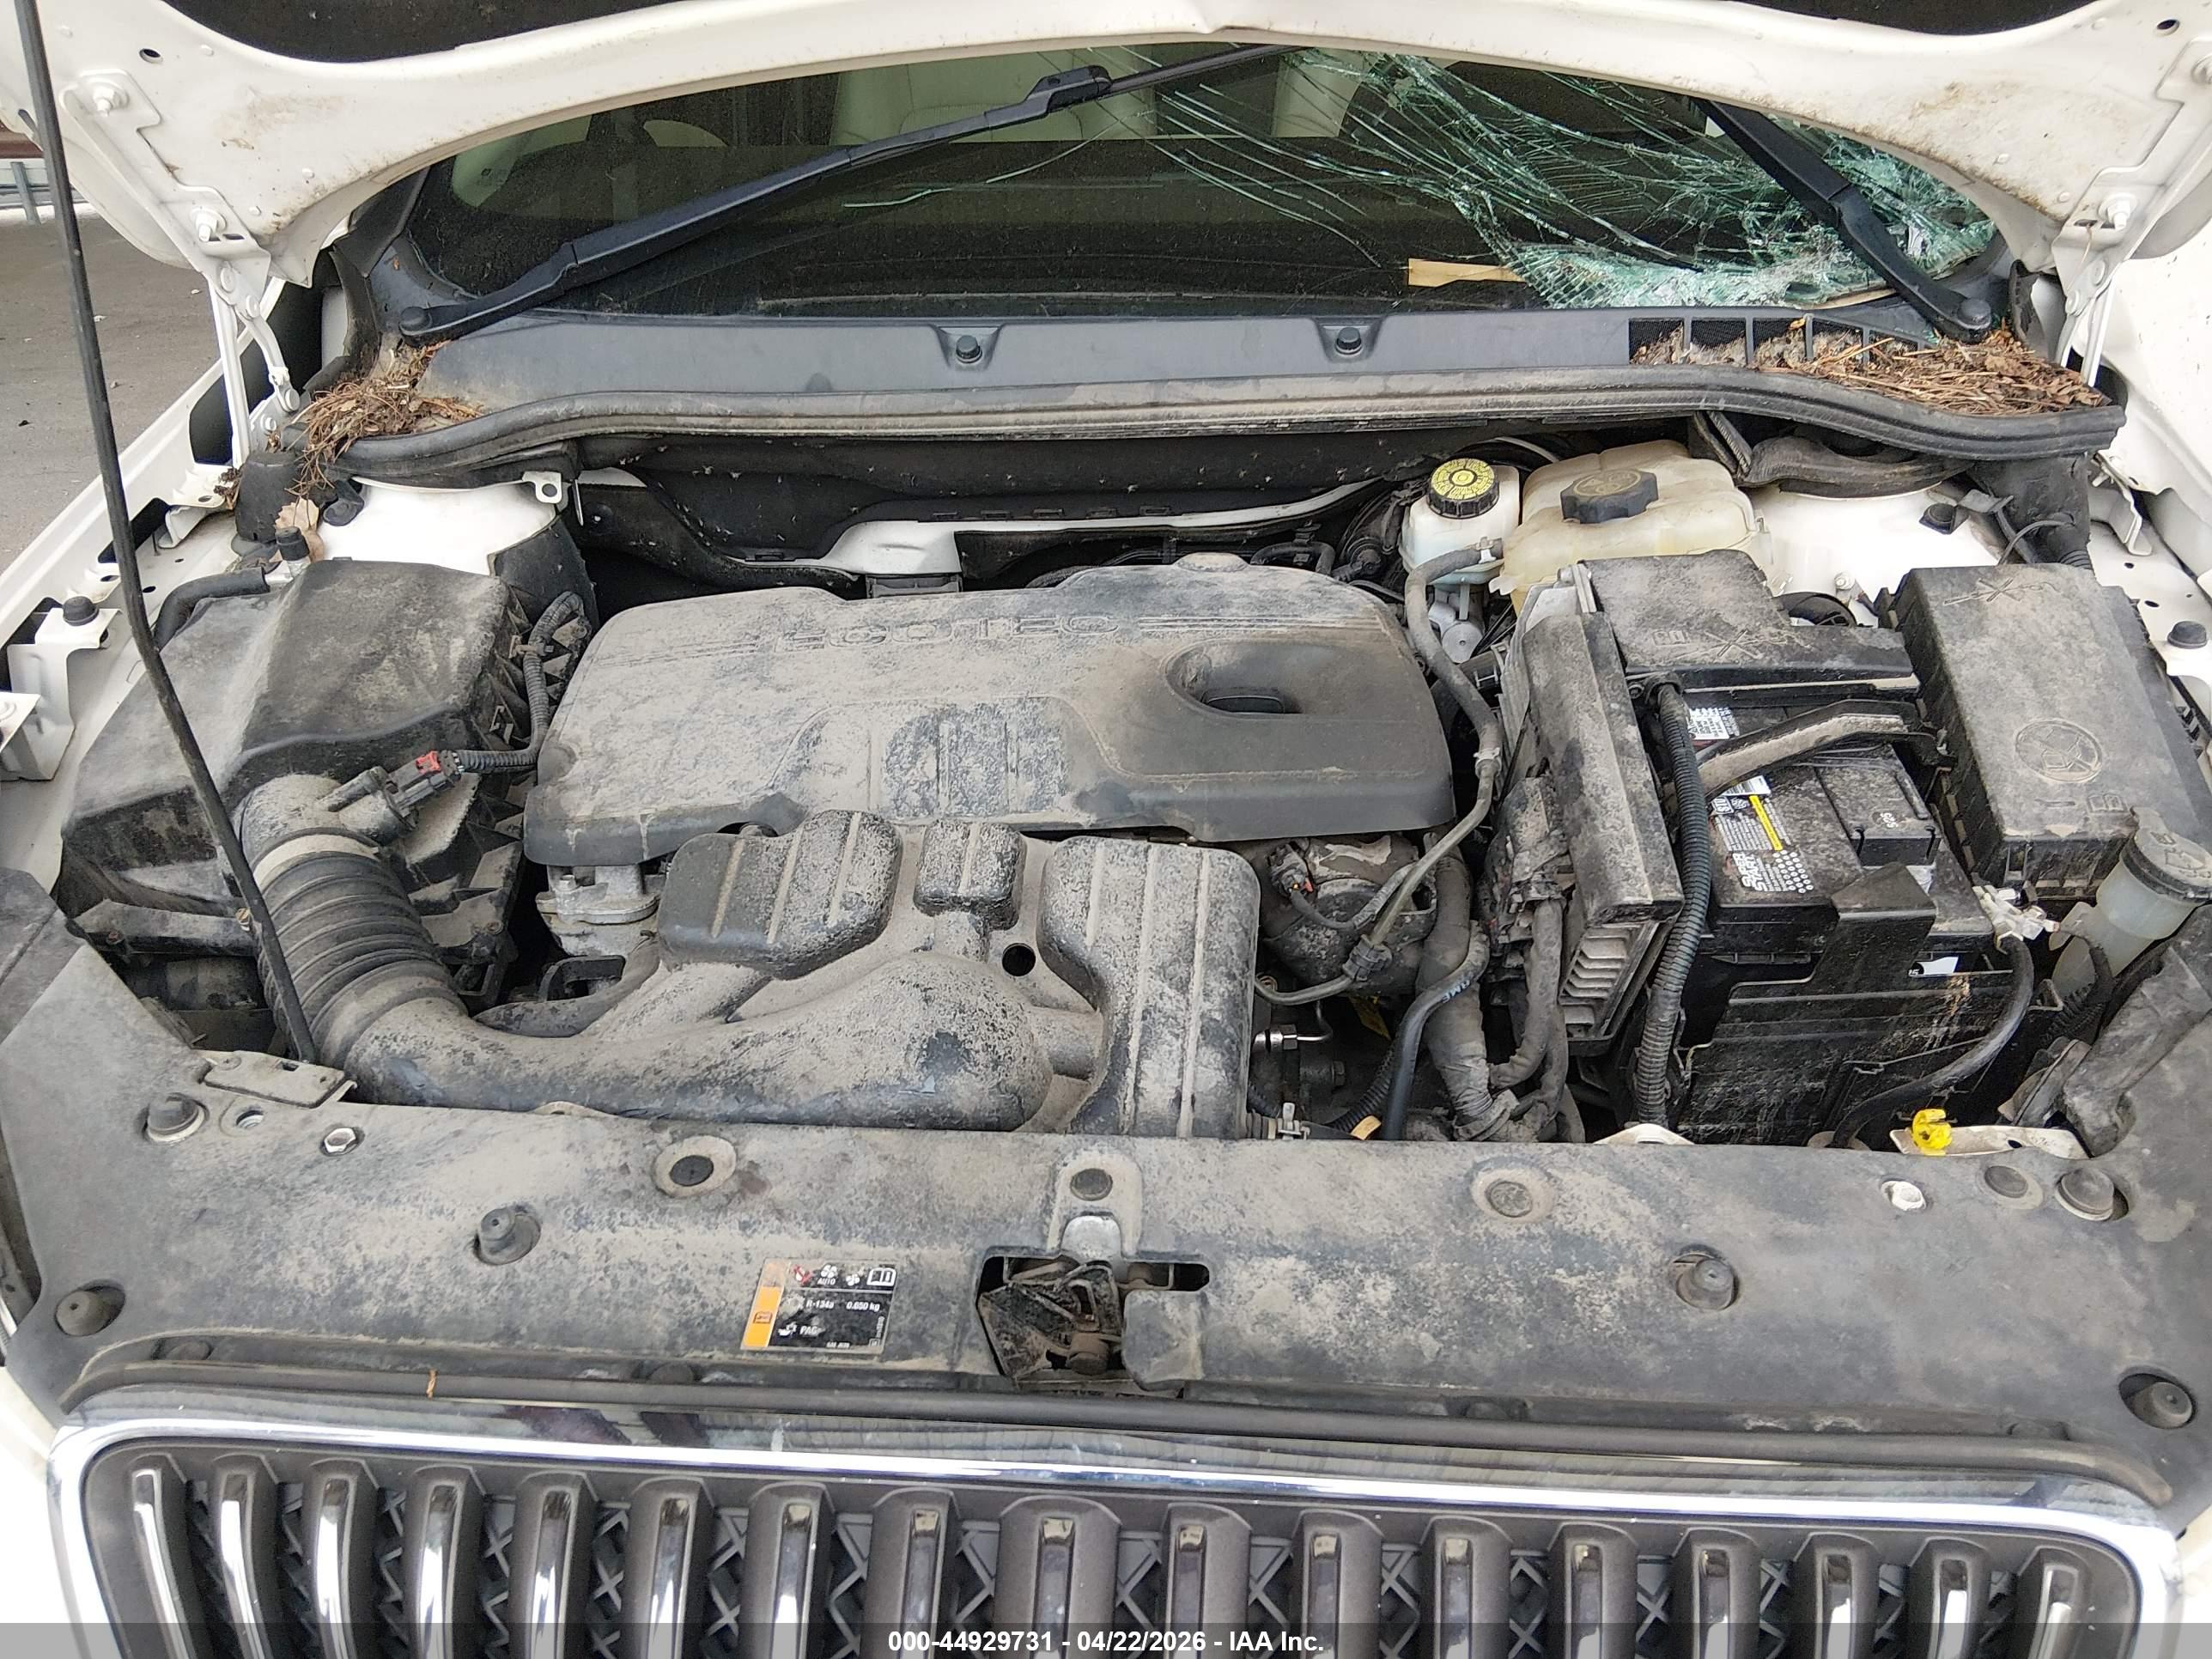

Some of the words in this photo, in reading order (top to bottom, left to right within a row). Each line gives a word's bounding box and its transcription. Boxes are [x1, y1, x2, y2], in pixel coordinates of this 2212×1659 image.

[1732, 853, 1753, 888] SUPER
[1746, 854, 1769, 892] START
[817, 1277, 836, 1285] AUTO
[869, 1301, 881, 1312] kg
